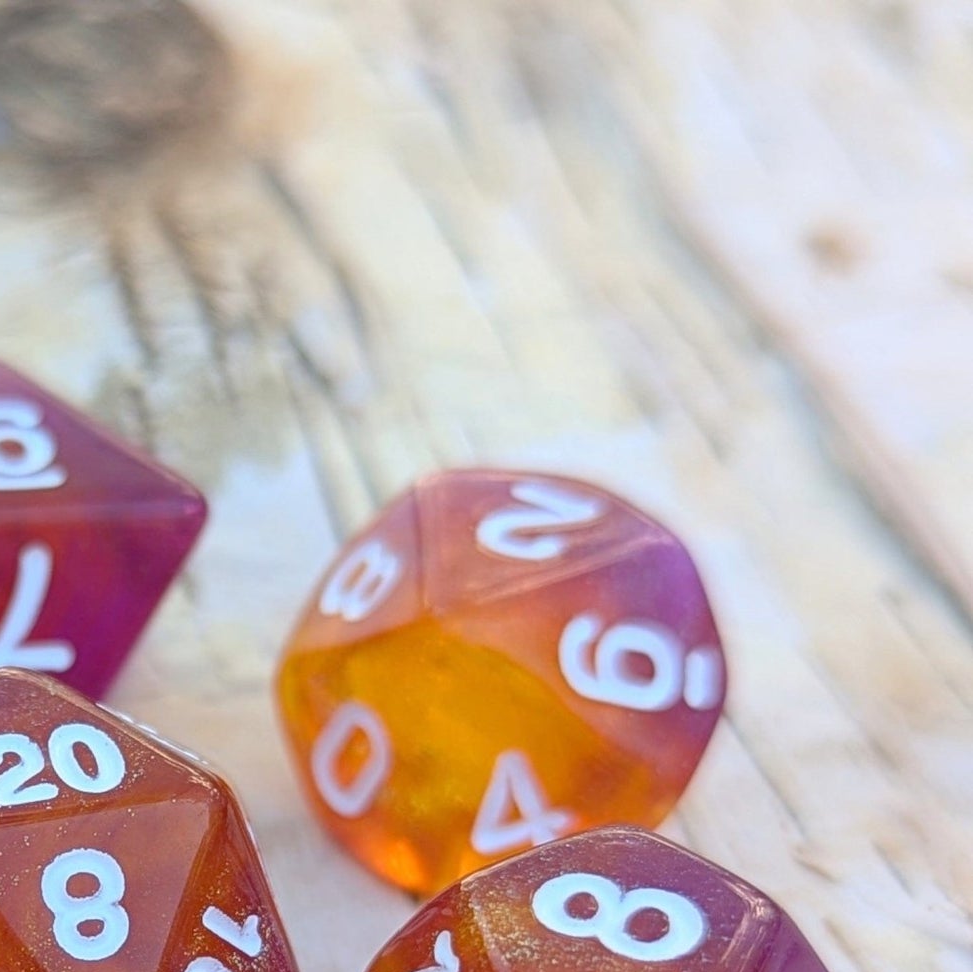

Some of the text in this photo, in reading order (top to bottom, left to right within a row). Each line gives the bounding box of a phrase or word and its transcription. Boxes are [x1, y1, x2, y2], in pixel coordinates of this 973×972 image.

[476, 482, 605, 561] 2
[320, 541, 400, 622] 8
[559, 614, 719, 711] 6
[311, 702, 391, 818] 0
[470, 750, 575, 854] 4
[41, 848, 129, 961] 8
[532, 872, 709, 962] 8
